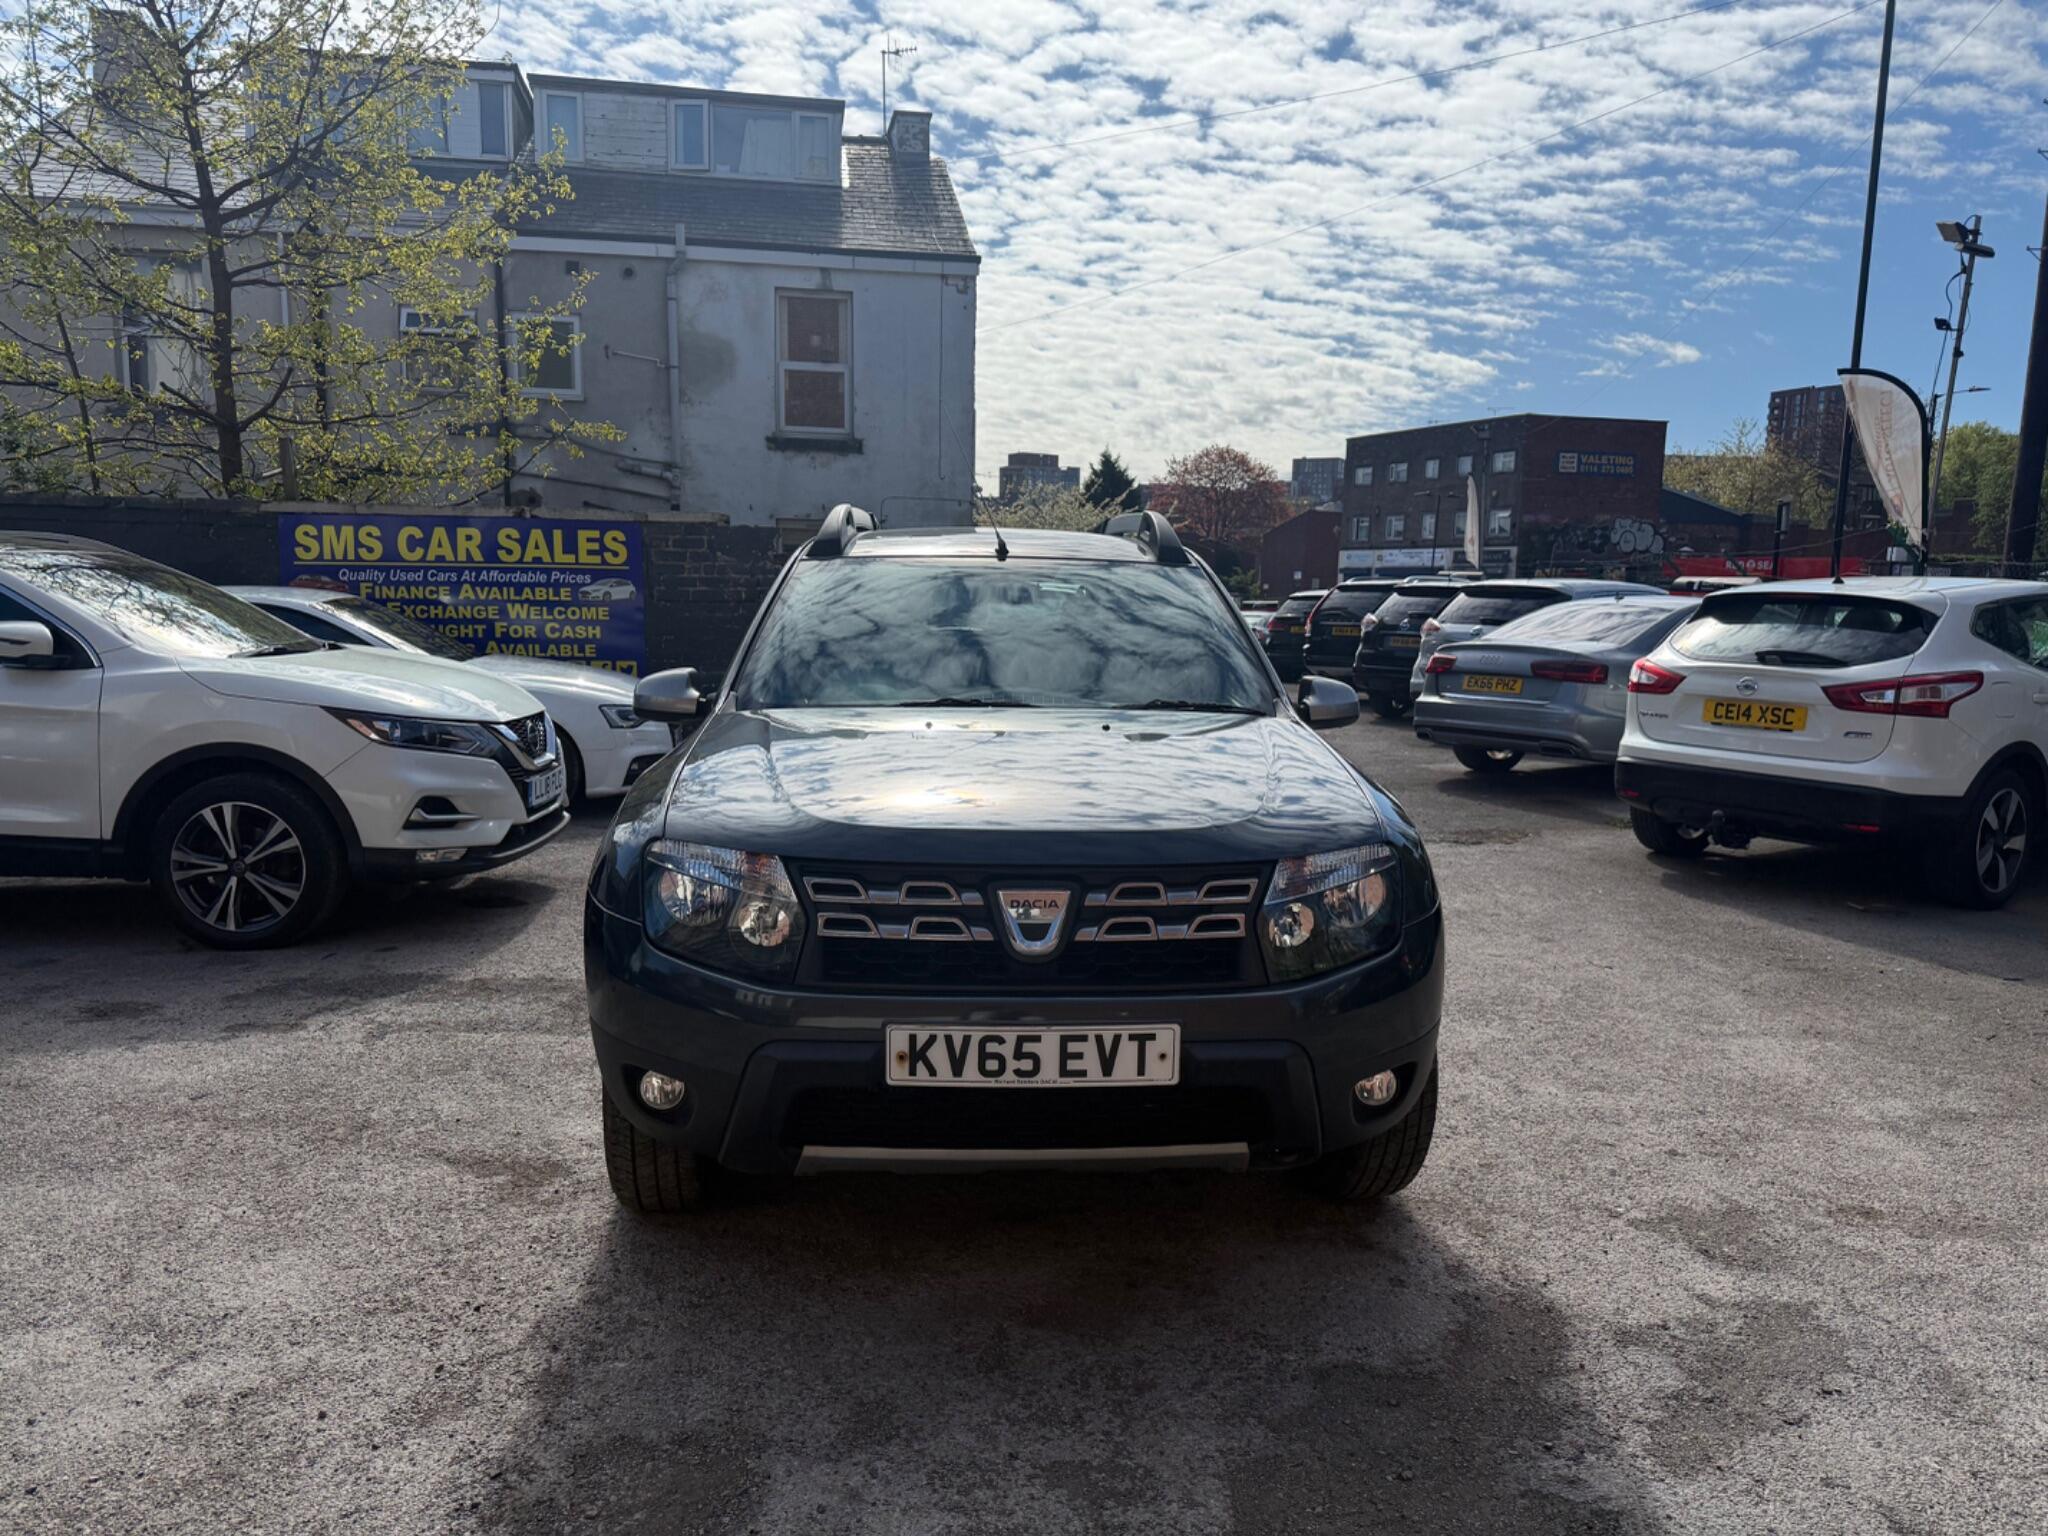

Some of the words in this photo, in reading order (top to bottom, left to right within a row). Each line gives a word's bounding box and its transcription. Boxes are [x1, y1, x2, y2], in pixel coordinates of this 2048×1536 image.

[1580, 454, 1634, 465] VALETING
[294, 524, 383, 561] SMS
[397, 526, 484, 562] CAR
[497, 527, 628, 565] SALES
[338, 568, 385, 584] Quality
[390, 569, 424, 581] Used
[427, 569, 457, 582] Cars
[461, 570, 476, 582] At
[479, 570, 547, 583] Affordable
[551, 572, 591, 584] Prices
[359, 582, 450, 599] FINANCE
[459, 584, 572, 600] AVAILABLE
[507, 603, 610, 620] WELCOME
[495, 622, 537, 638] FOR
[545, 622, 601, 639] CASH
[1713, 703, 1752, 721] CE14
[1757, 707, 1796, 726] XSC
[1010, 899, 1060, 909] DACIA
[908, 1034, 1042, 1078] KV65
[1059, 1034, 1156, 1078] EVT
